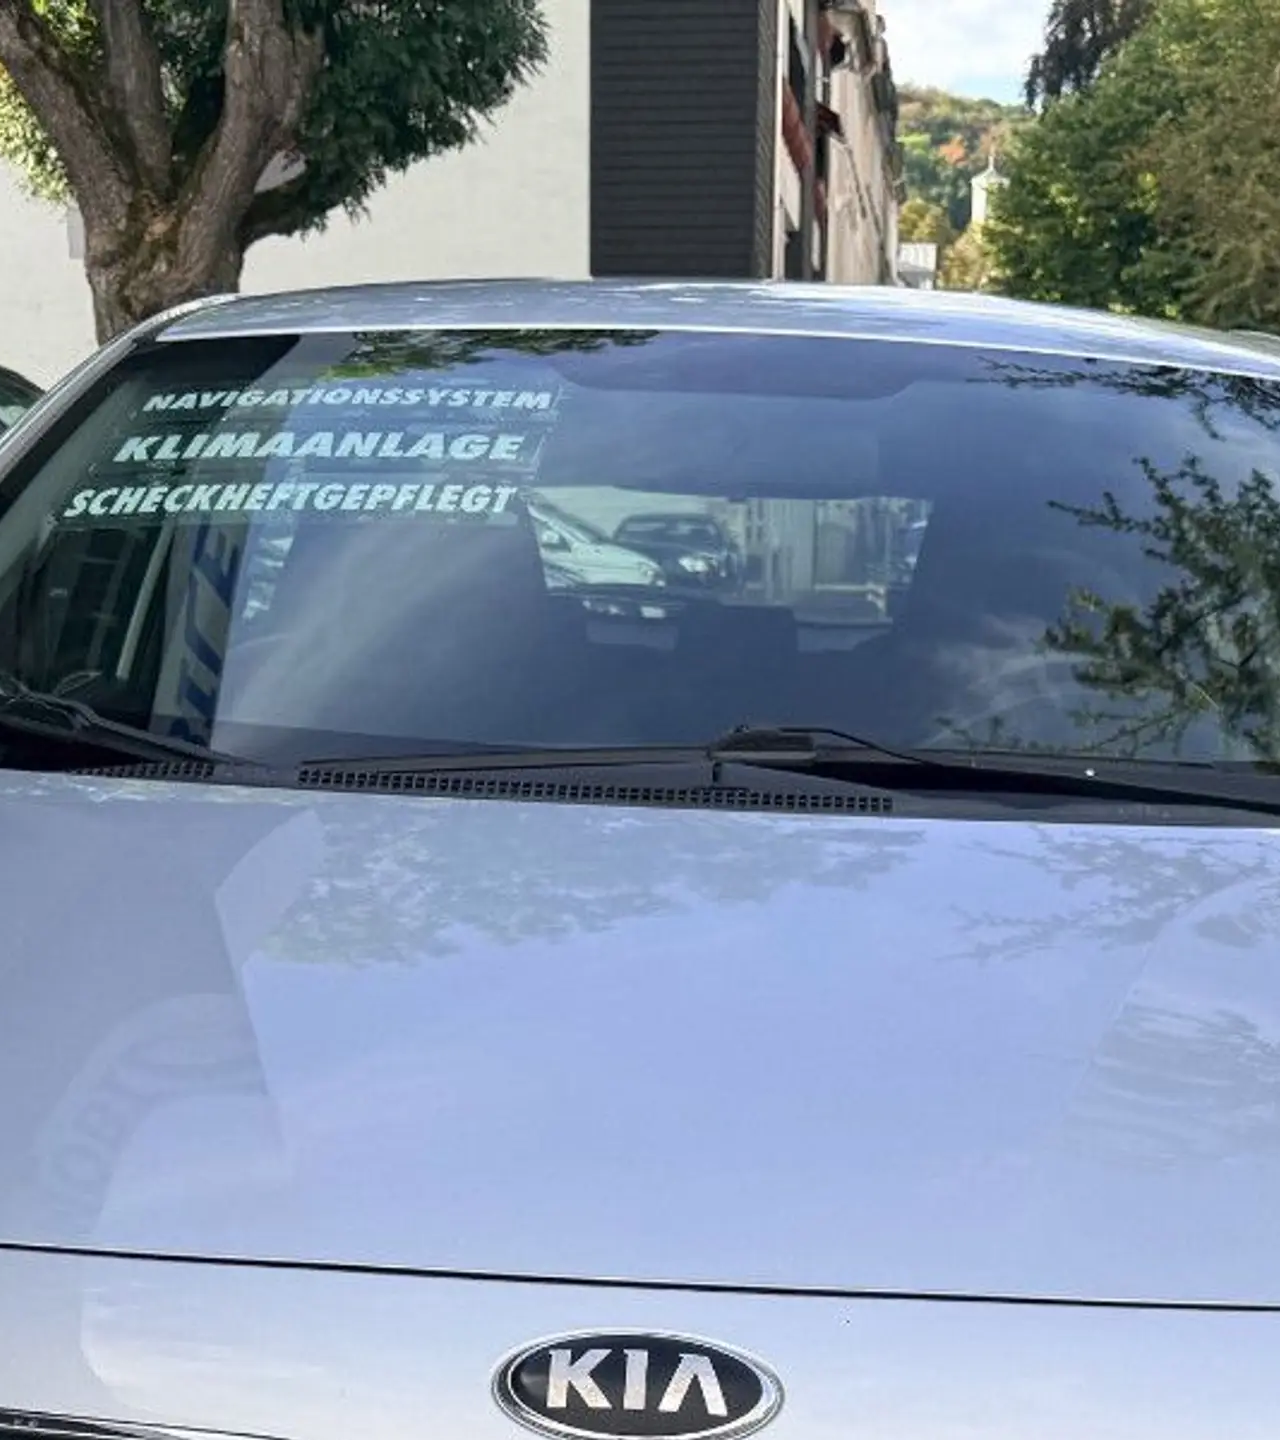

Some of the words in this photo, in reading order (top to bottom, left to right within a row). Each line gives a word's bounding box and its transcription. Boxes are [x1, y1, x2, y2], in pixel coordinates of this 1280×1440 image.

[142, 387, 553, 411] NAVIGATIONSSYSTEM
[113, 431, 525, 463] KLIMAANLAGE
[62, 483, 519, 519] SCHECKHEFTGEPFLEGT
[546, 1348, 728, 1417] KIA
